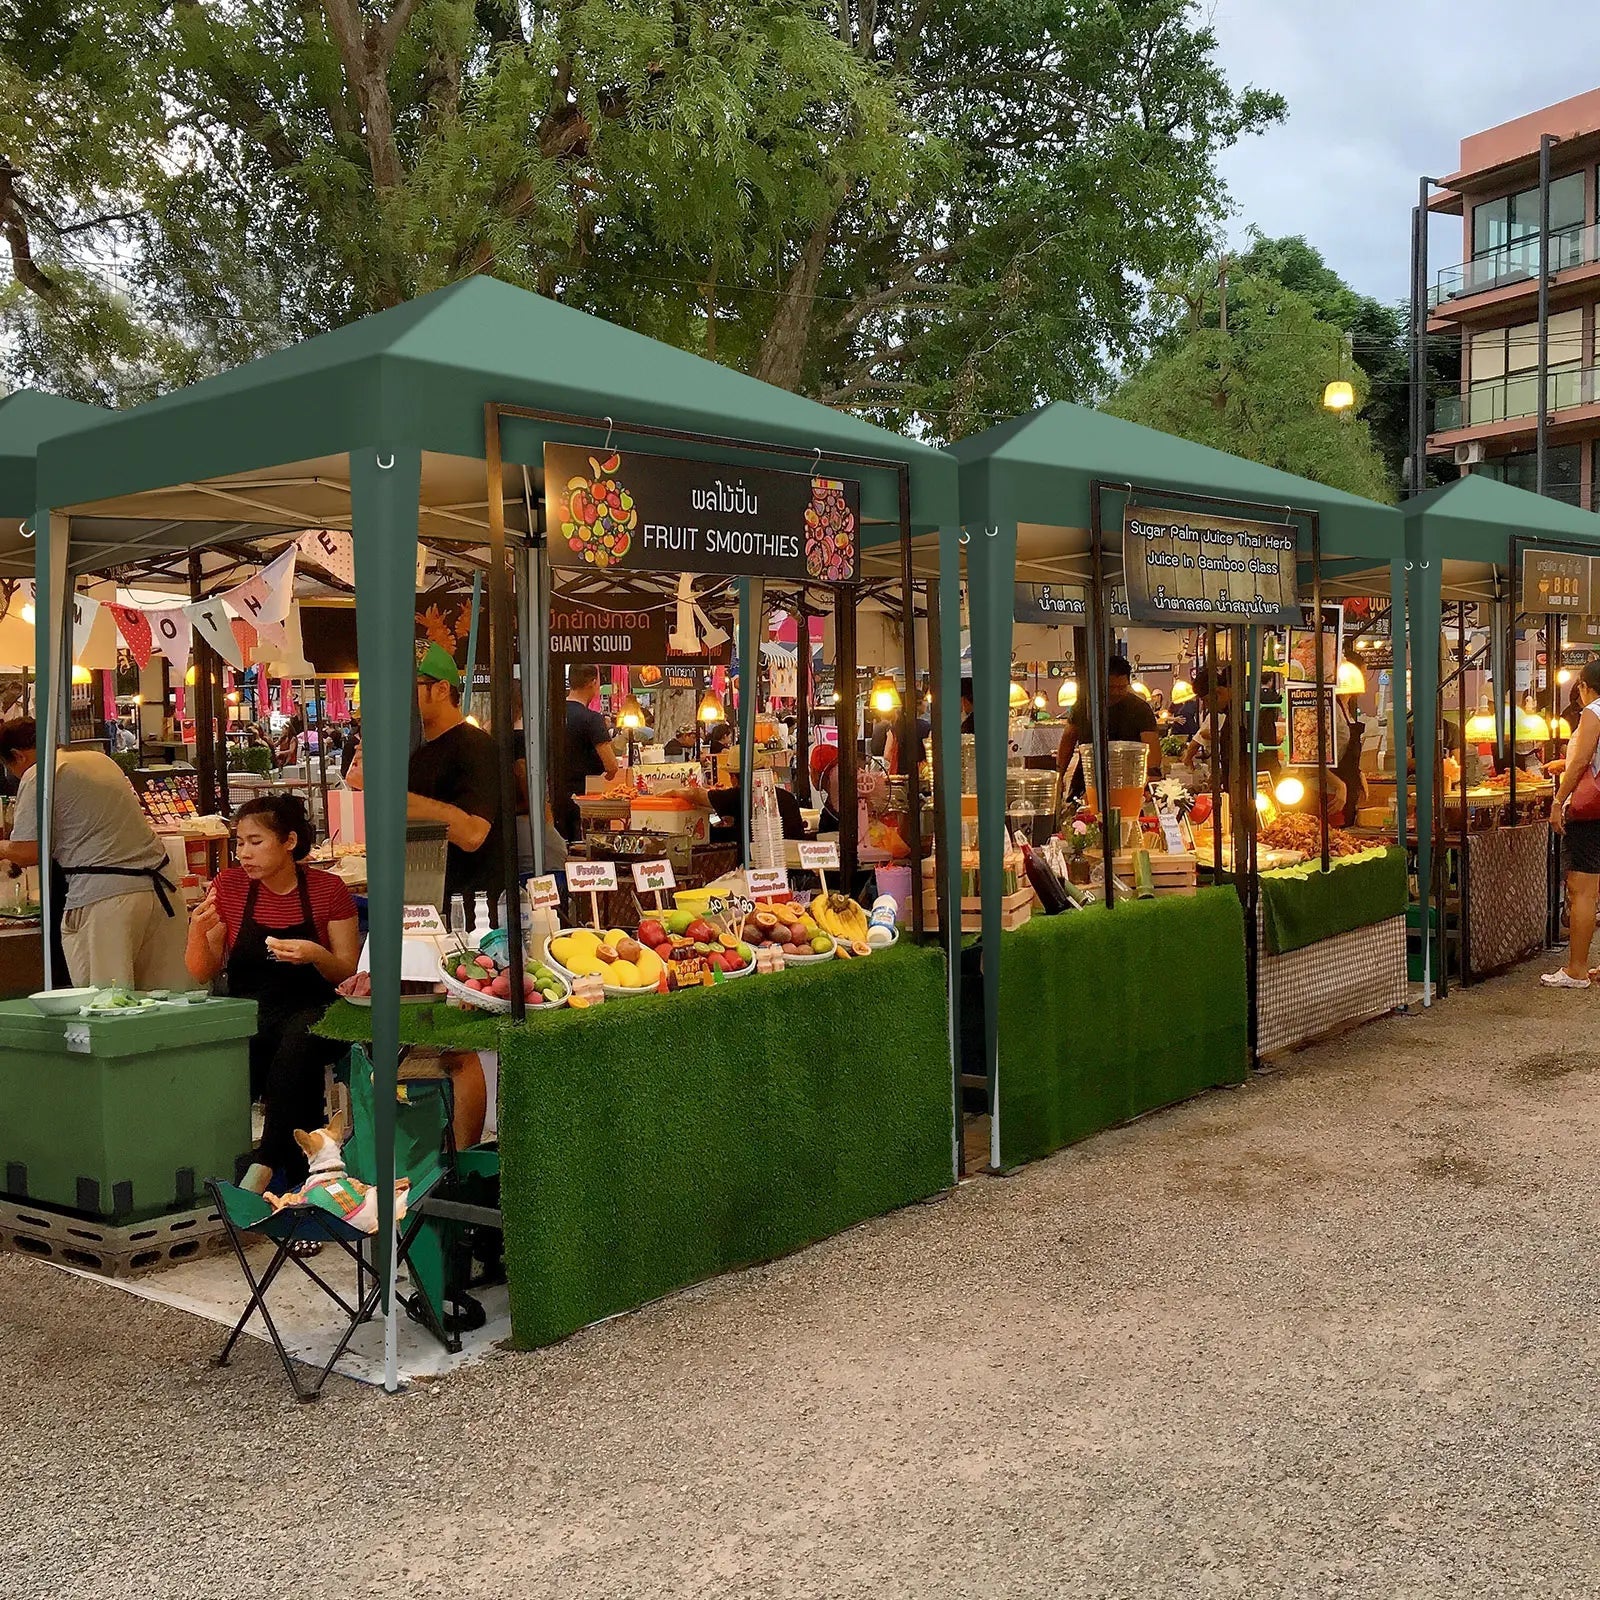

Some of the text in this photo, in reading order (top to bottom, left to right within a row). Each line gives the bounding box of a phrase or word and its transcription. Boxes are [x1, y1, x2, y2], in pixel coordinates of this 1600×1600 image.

[692, 479, 758, 515] ผลไม้ปั่น
[643, 524, 799, 558] FRUIT SMOOTHIES
[1130, 521, 1292, 550] Sugar Palm Juice Thai Herb
[1147, 551, 1278, 574] Juice In Bamboo Glass
[1039, 585, 1085, 612] น้ำตาล
[1153, 585, 1212, 611] น้ำตาลสด
[1216, 590, 1280, 619] น้ำสมุนไพร
[550, 635, 632, 652] GIANT SQUID
[640, 864, 665, 876] Apple
[710, 899, 722, 912] 40
[741, 899, 753, 913] 80
